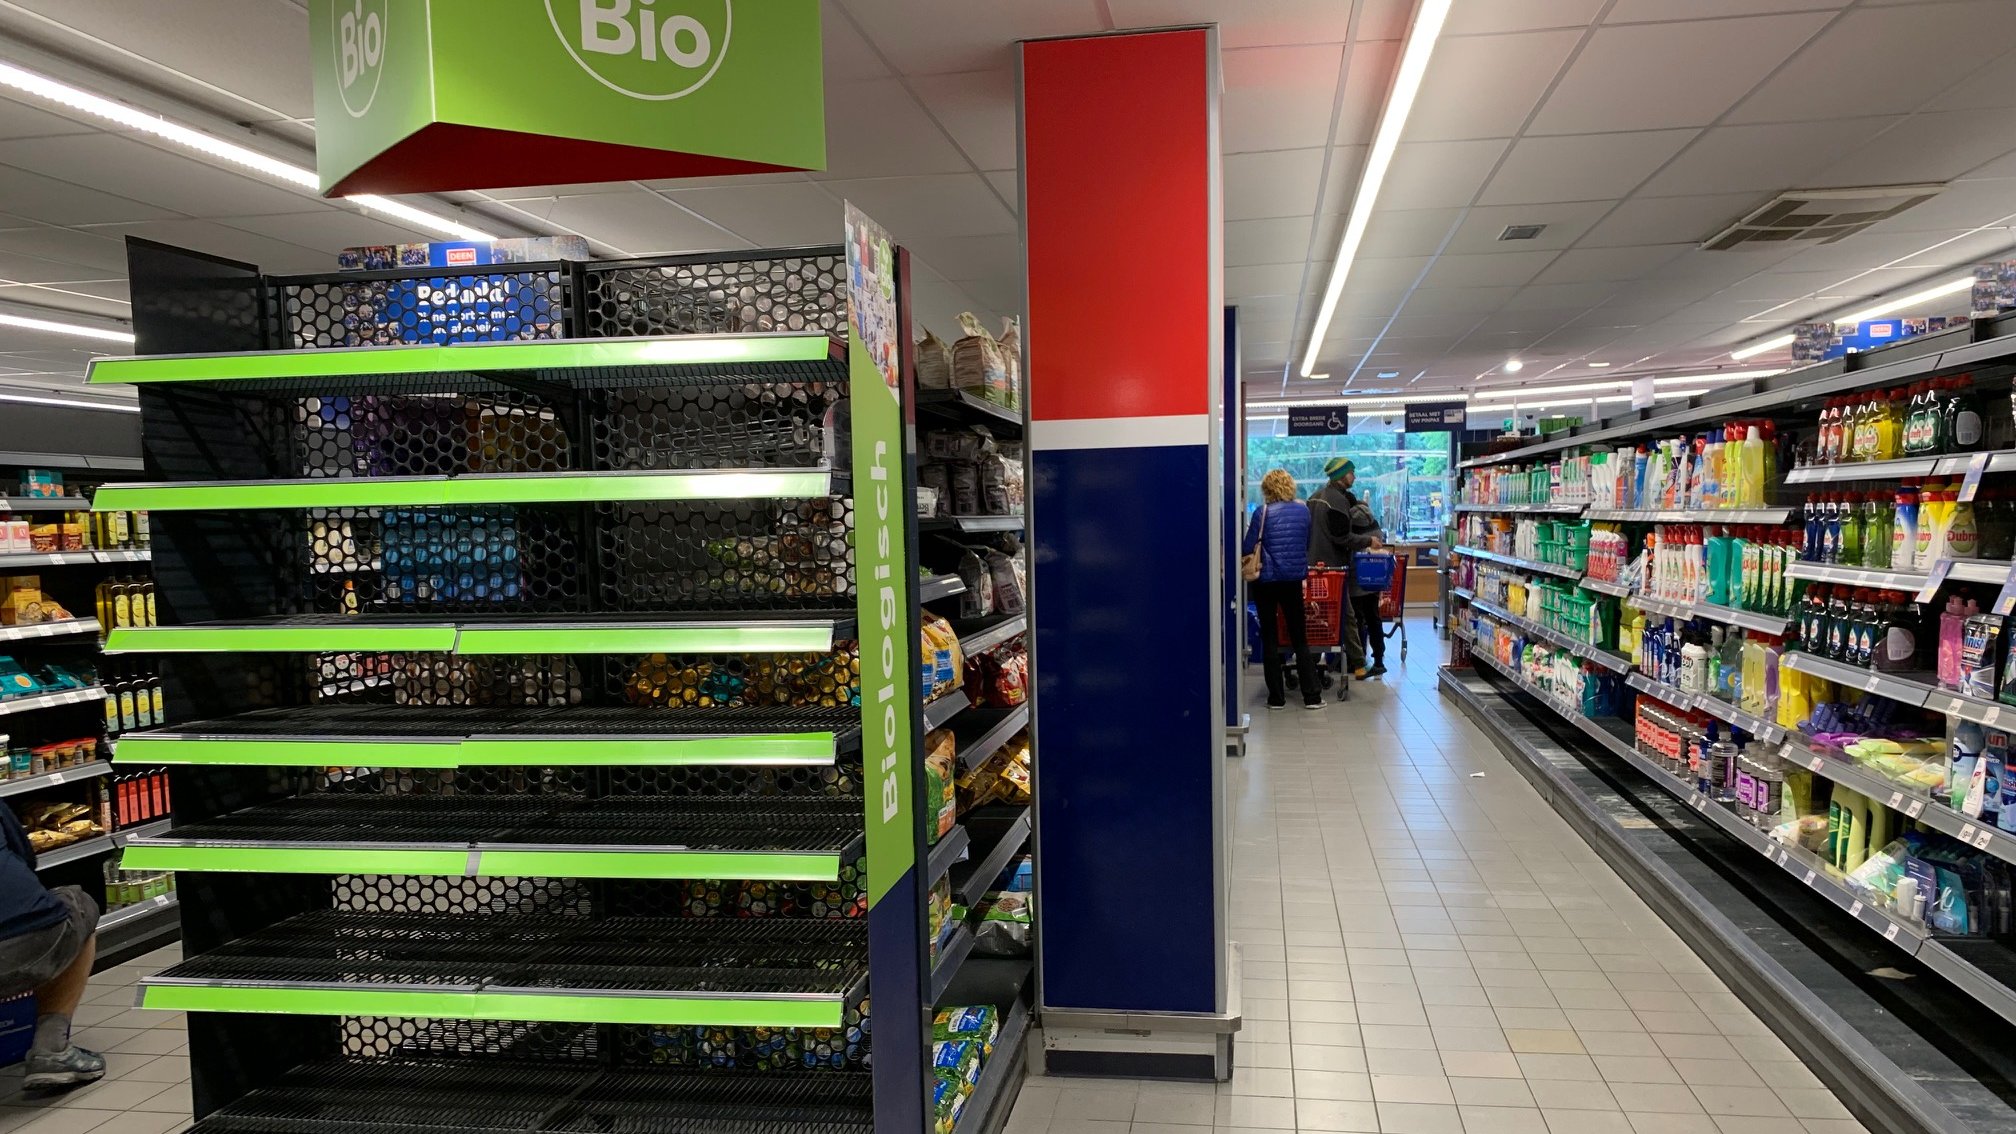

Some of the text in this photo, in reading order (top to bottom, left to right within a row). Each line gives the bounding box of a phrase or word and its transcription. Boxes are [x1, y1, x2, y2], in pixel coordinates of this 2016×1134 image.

[341, 0, 381, 88] Bio
[580, 0, 711, 68] Bio
[450, 252, 473, 260] DEEN
[870, 440, 898, 824] Biologisch
